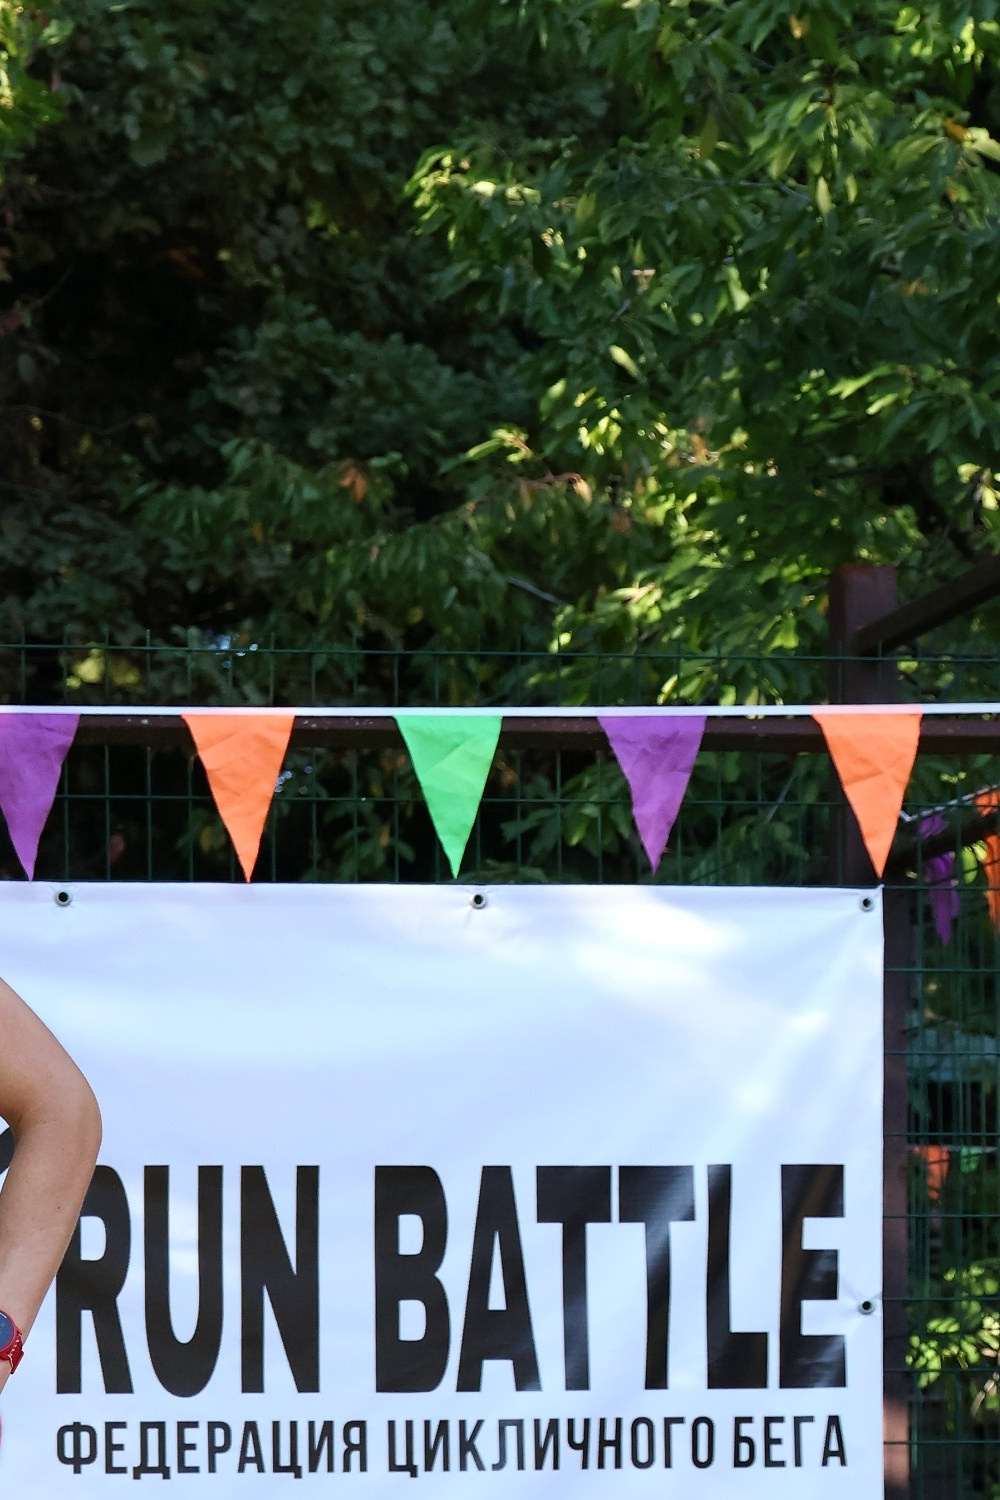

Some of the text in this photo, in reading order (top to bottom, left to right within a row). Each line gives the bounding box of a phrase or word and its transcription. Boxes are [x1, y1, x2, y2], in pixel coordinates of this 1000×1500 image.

[56, 1163, 848, 1398] RUN BATTLE
[56, 1414, 849, 1481] ФЕДЕРАЦИЯ ЦИКЛИЧНОГО БЕГА
